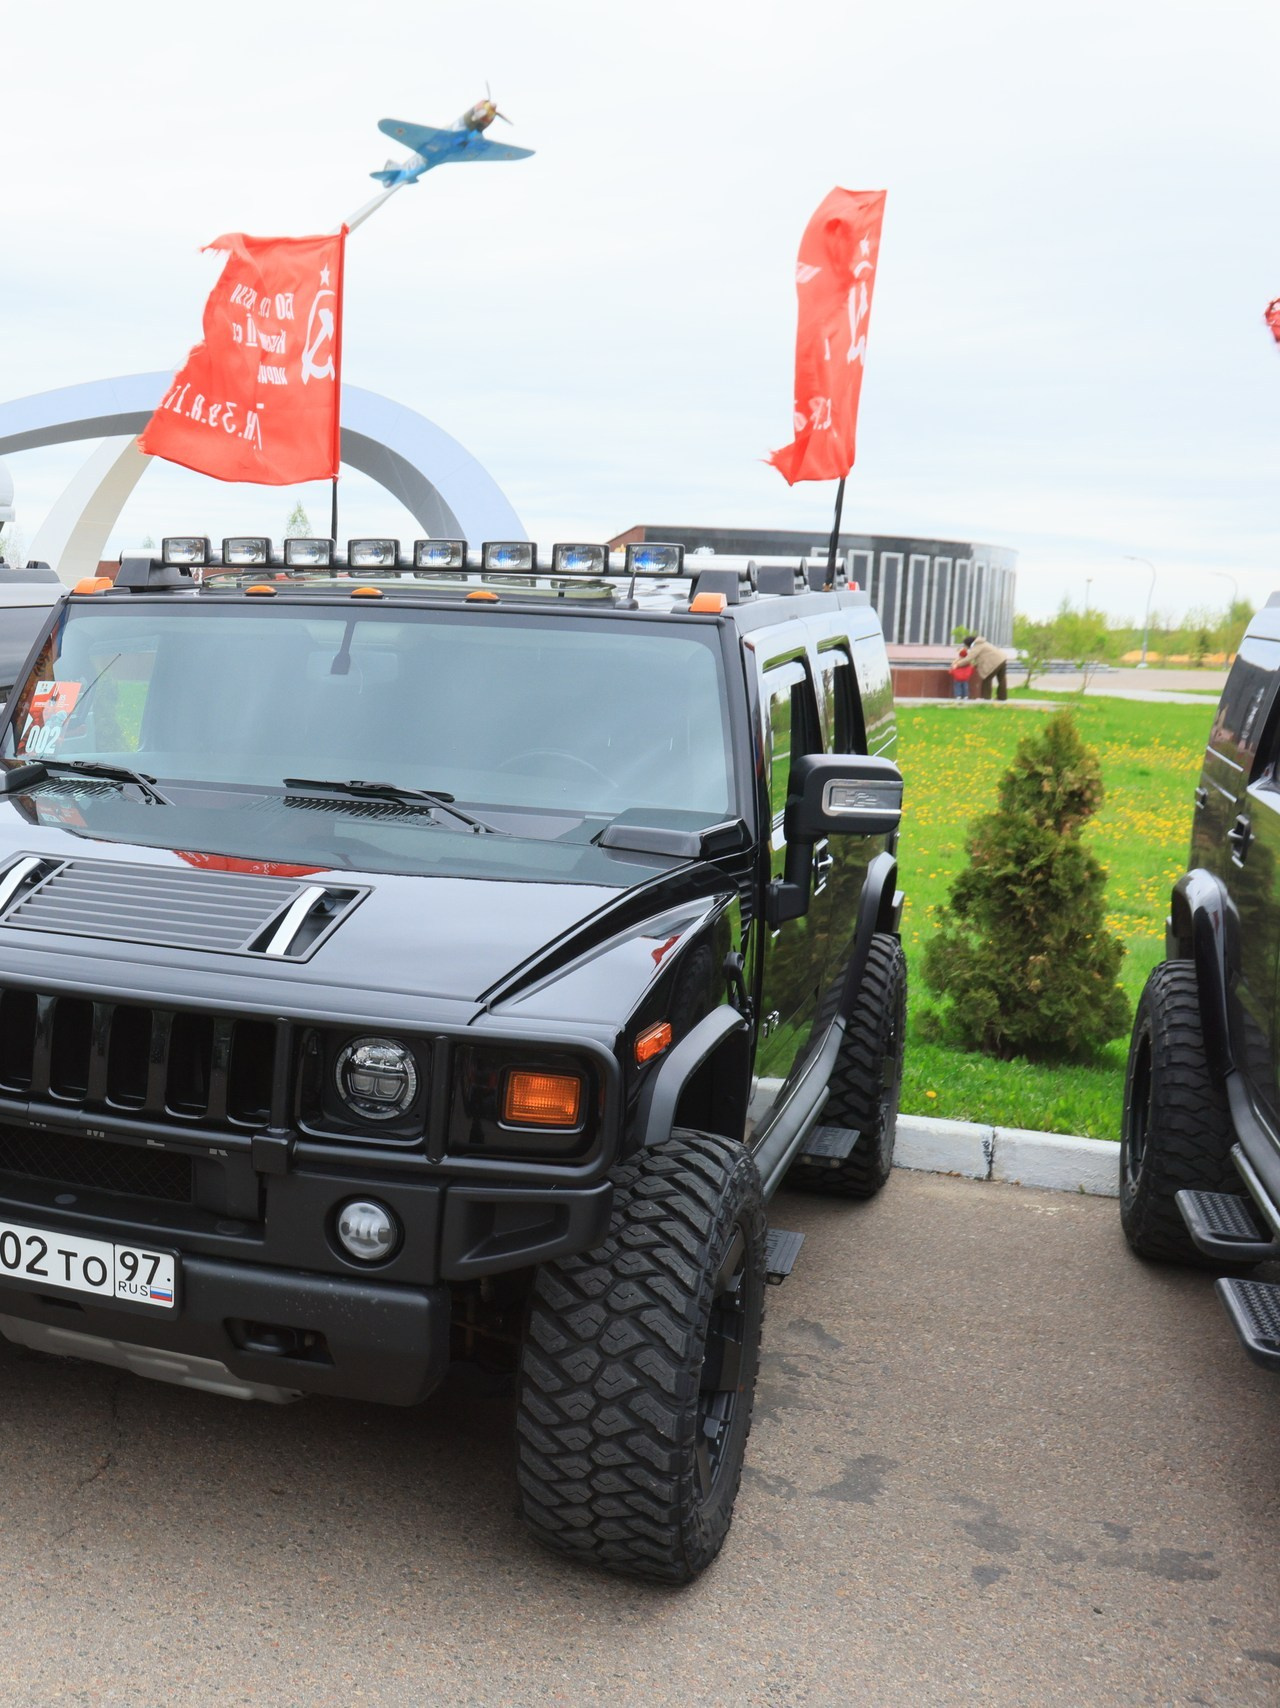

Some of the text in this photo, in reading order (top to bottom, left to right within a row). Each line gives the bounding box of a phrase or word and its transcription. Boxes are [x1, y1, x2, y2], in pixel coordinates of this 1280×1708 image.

[25, 725, 63, 754] 002
[119, 1251, 160, 1285] 97
[118, 1281, 149, 1297] RUS
